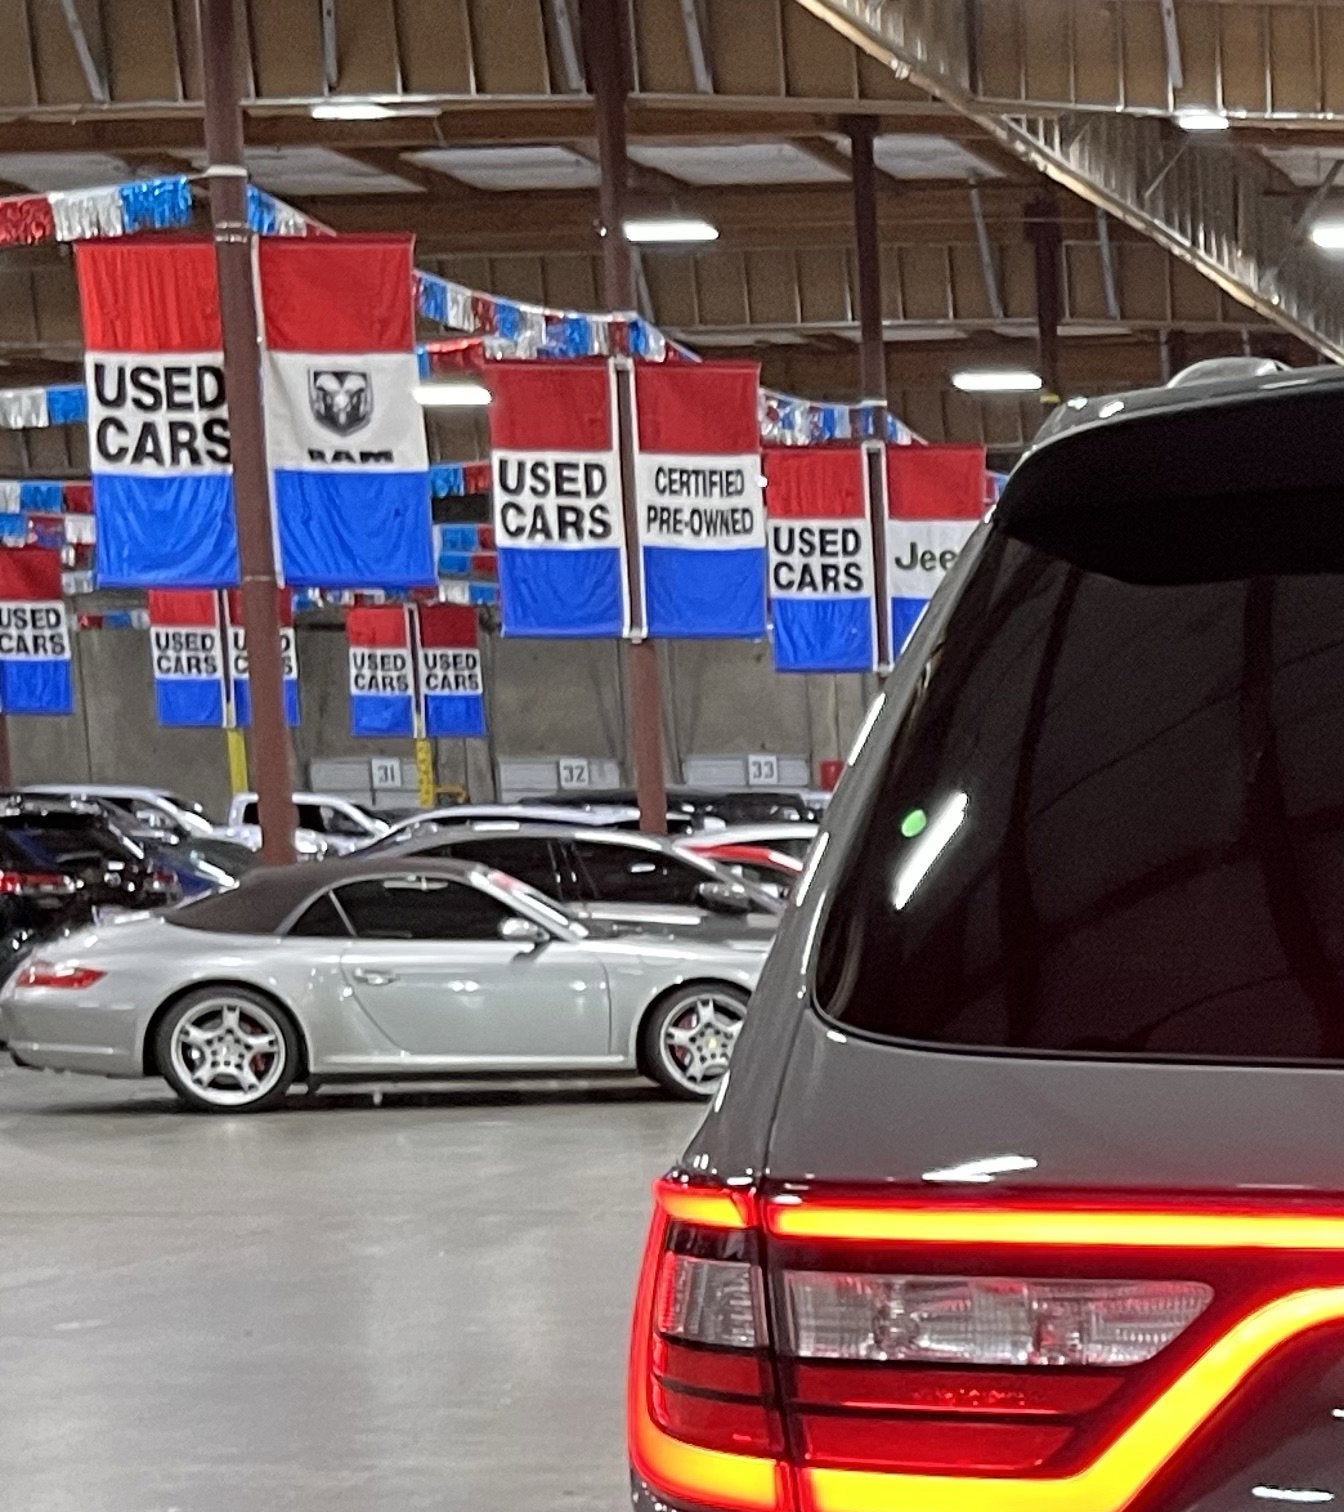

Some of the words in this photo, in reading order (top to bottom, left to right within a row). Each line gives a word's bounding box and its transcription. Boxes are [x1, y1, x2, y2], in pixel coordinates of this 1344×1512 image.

[94, 363, 226, 411] USED
[96, 416, 232, 466] CARS
[307, 448, 395, 464] RAM
[499, 459, 607, 498] USED
[655, 467, 745, 497] CERTIFIED
[500, 504, 612, 541] CARS
[646, 507, 754, 536] PRE-OWNED
[773, 527, 862, 557] USED
[895, 542, 958, 572] Jee
[774, 562, 863, 591] CARS
[0, 608, 62, 630] USED
[0, 633, 66, 655] CARS
[155, 632, 215, 651] USED
[233, 632, 291, 651] UD
[156, 655, 217, 674] CARS
[353, 653, 406, 671] USED
[424, 653, 477, 671] USED
[354, 673, 408, 691] CARS
[425, 673, 479, 691] CARS
[377, 764, 395, 782] 31
[563, 765, 586, 783] 32
[751, 761, 775, 779] 33
